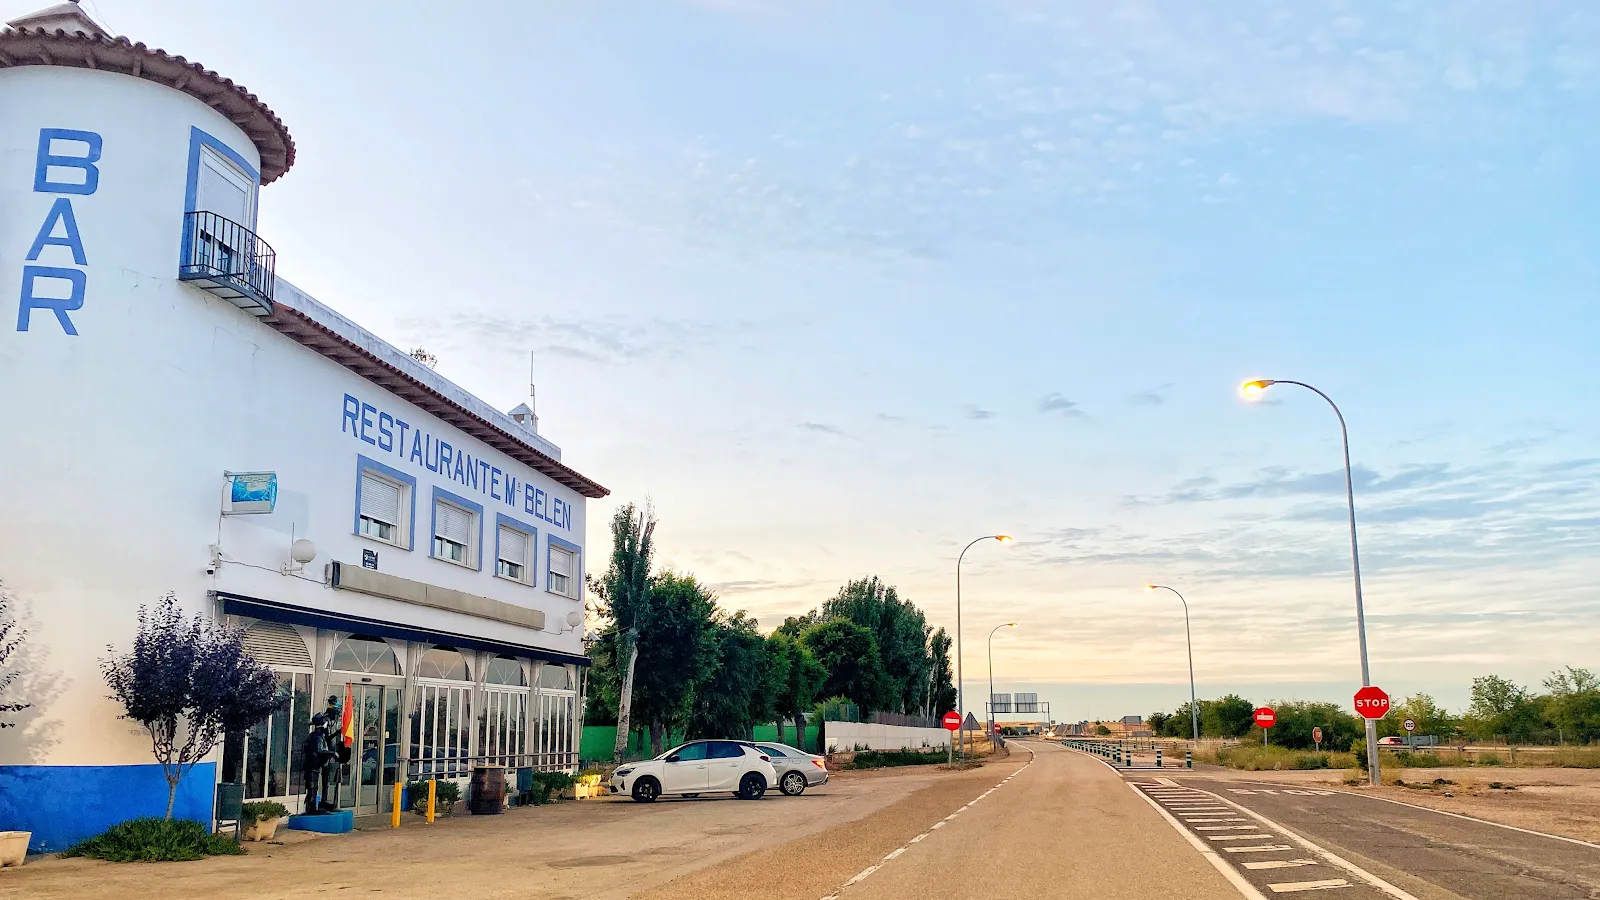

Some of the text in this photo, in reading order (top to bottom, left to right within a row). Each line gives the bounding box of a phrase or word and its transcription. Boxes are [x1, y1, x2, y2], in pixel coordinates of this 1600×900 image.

[16, 128, 103, 336] BAR
[342, 393, 502, 501] RESTAURANTE
[525, 483, 571, 531] BELEN
[1356, 699, 1388, 707] STOP
